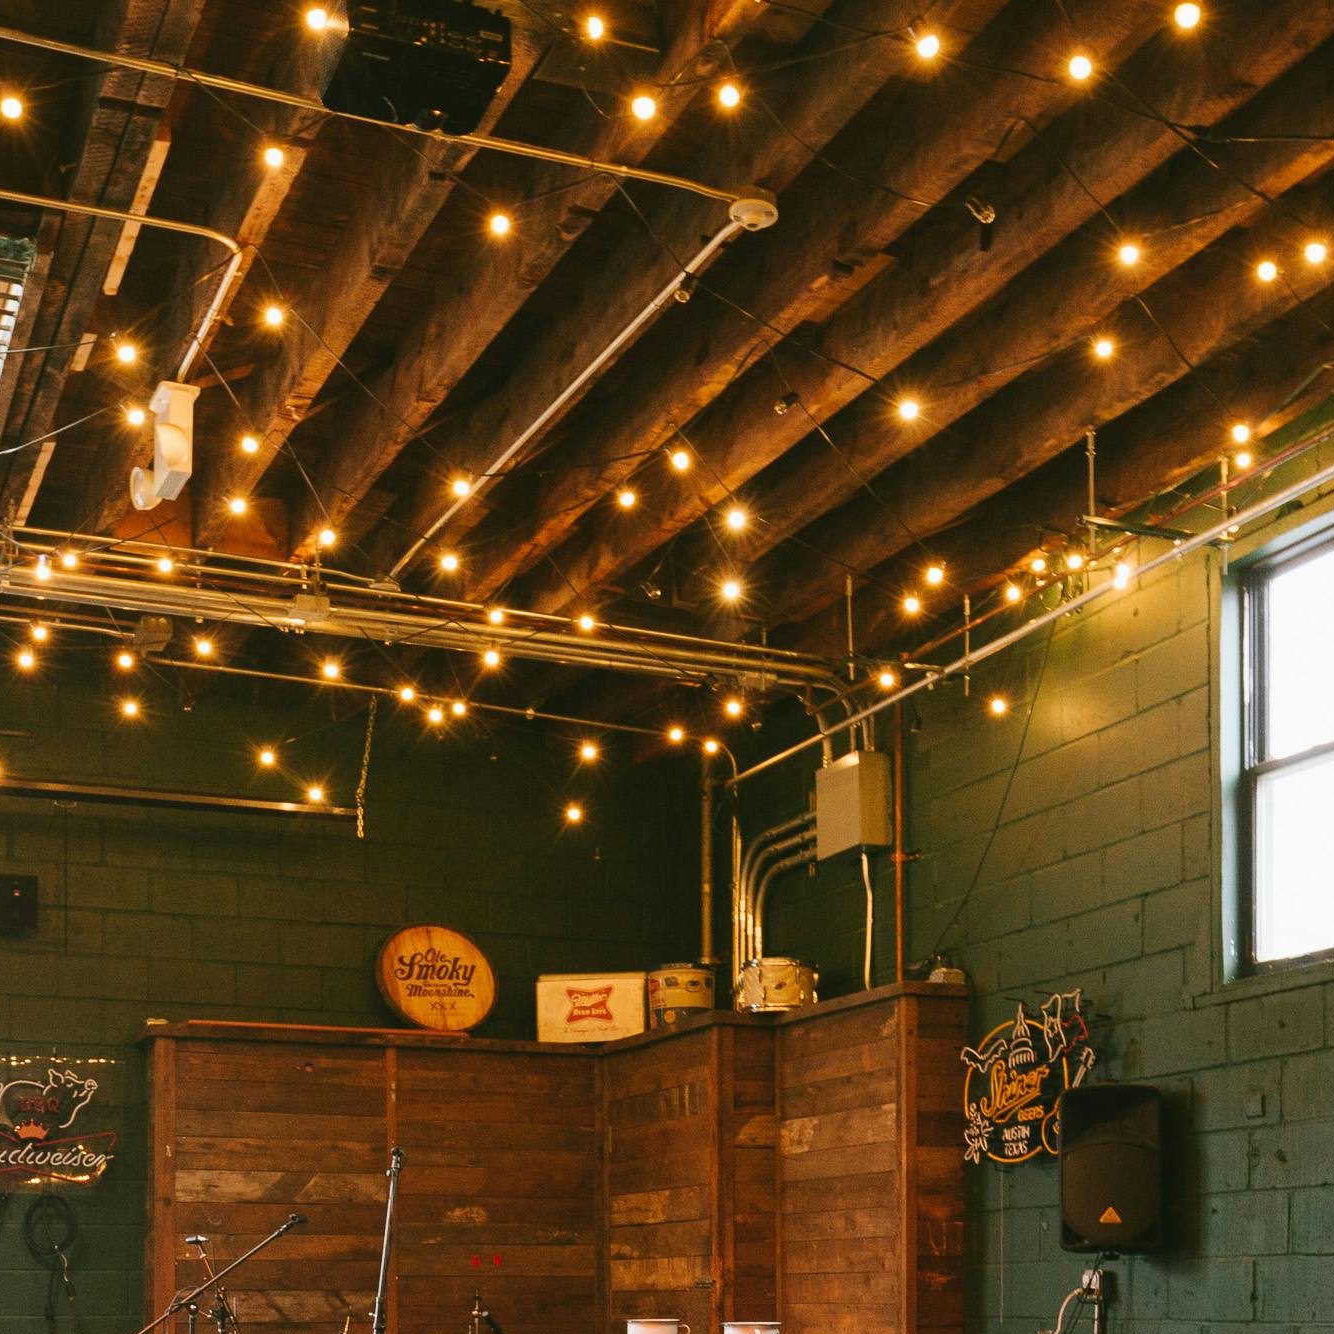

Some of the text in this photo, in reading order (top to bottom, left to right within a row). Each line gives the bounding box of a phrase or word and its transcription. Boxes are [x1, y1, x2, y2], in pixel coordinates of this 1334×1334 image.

[424, 947, 451, 963] Ole
[394, 952, 476, 987] Smoky
[406, 983, 476, 999] Moonshine
